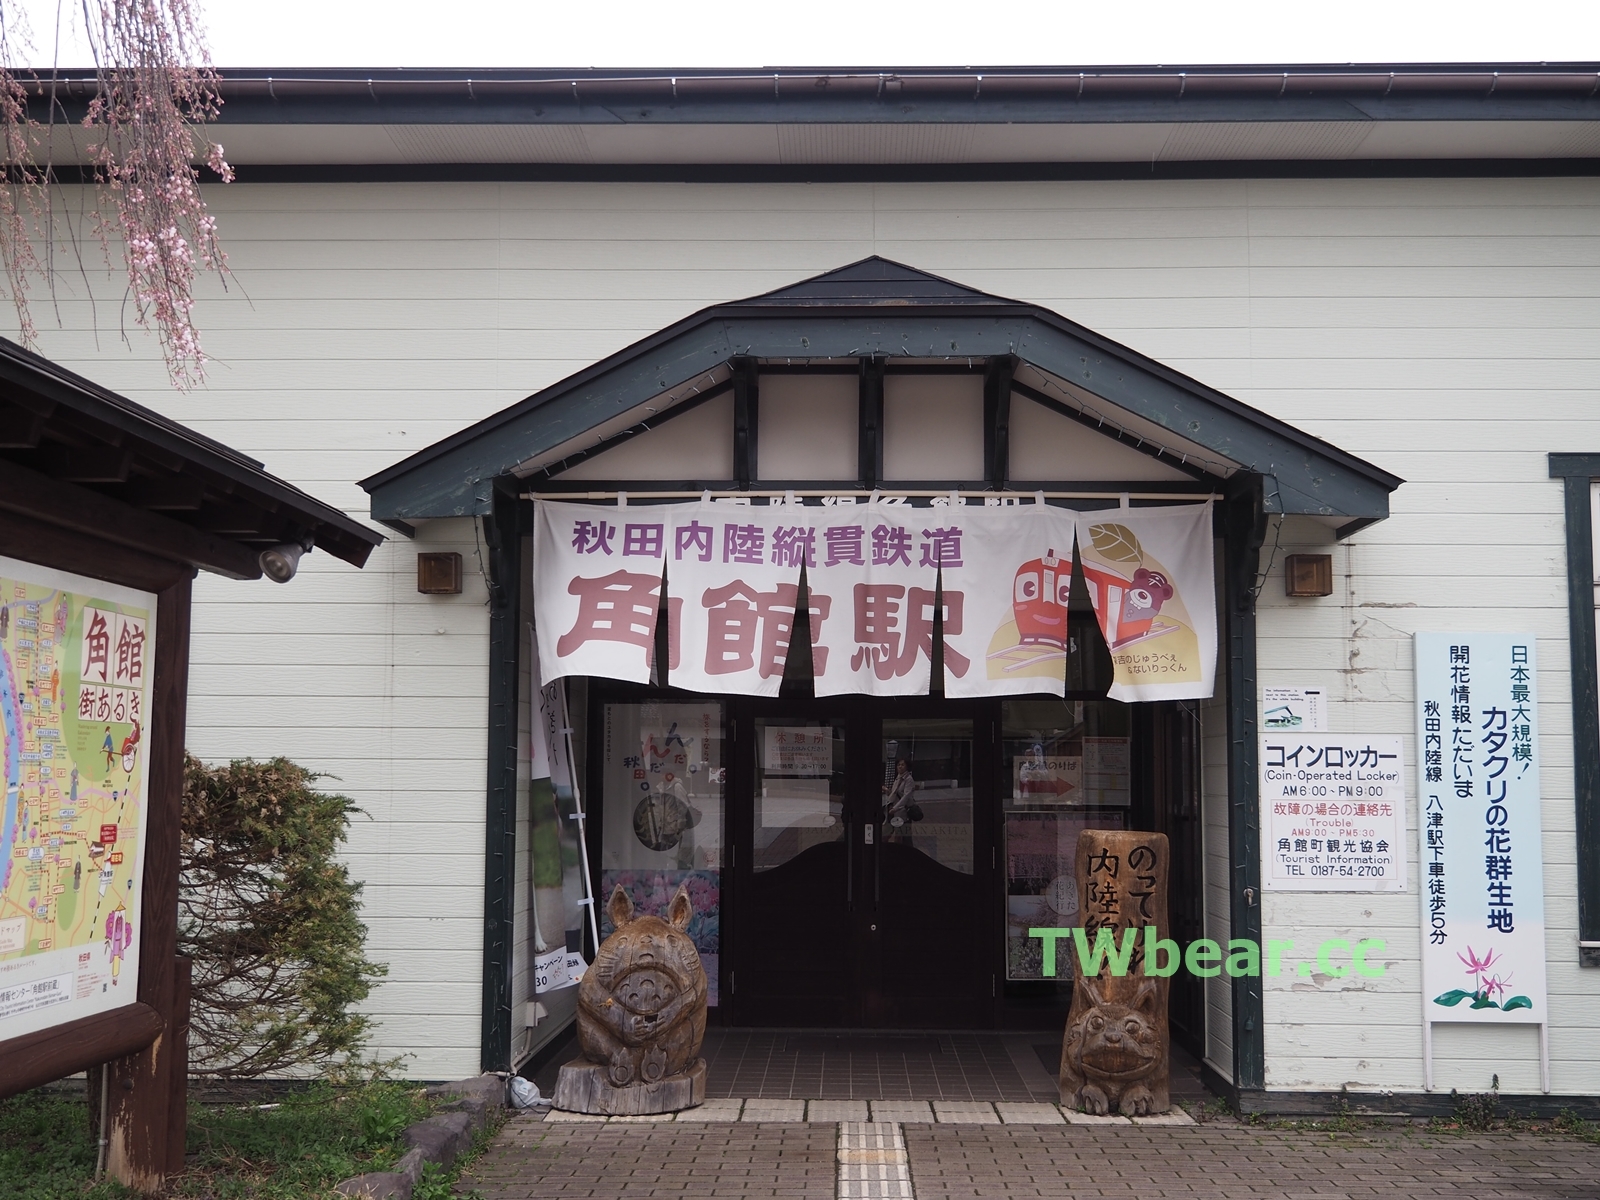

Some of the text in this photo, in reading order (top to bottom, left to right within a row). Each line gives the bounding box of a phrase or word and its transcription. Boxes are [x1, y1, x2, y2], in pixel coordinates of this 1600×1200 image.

[571, 520, 964, 568] 秋田内陸縦貫鉄道
[556, 568, 971, 681] 角館駅
[83, 609, 146, 683] 角館
[1128, 663, 1187, 674] &ないりっくん
[78, 687, 141, 724] 街あるき
[1510, 645, 1533, 781] 日本最大規模!
[775, 731, 825, 744] 休憩所
[1266, 745, 1397, 768] コインロッカー
[1264, 769, 1400, 783] (Coin-Operated Locker)
[1273, 802, 1393, 816] 故障の場合の連絡先
[1305, 818, 1354, 827] (Trouble)
[1424, 700, 1448, 944] 秋田内陸線 八津駅下車徒歩5分
[1481, 706, 1514, 934] カタクリの花群生地
[1277, 838, 1389, 853] 角館町観光協会
[1275, 854, 1393, 864] (Tourist Information)
[1285, 865, 1385, 877] TEL 0187-54-2700
